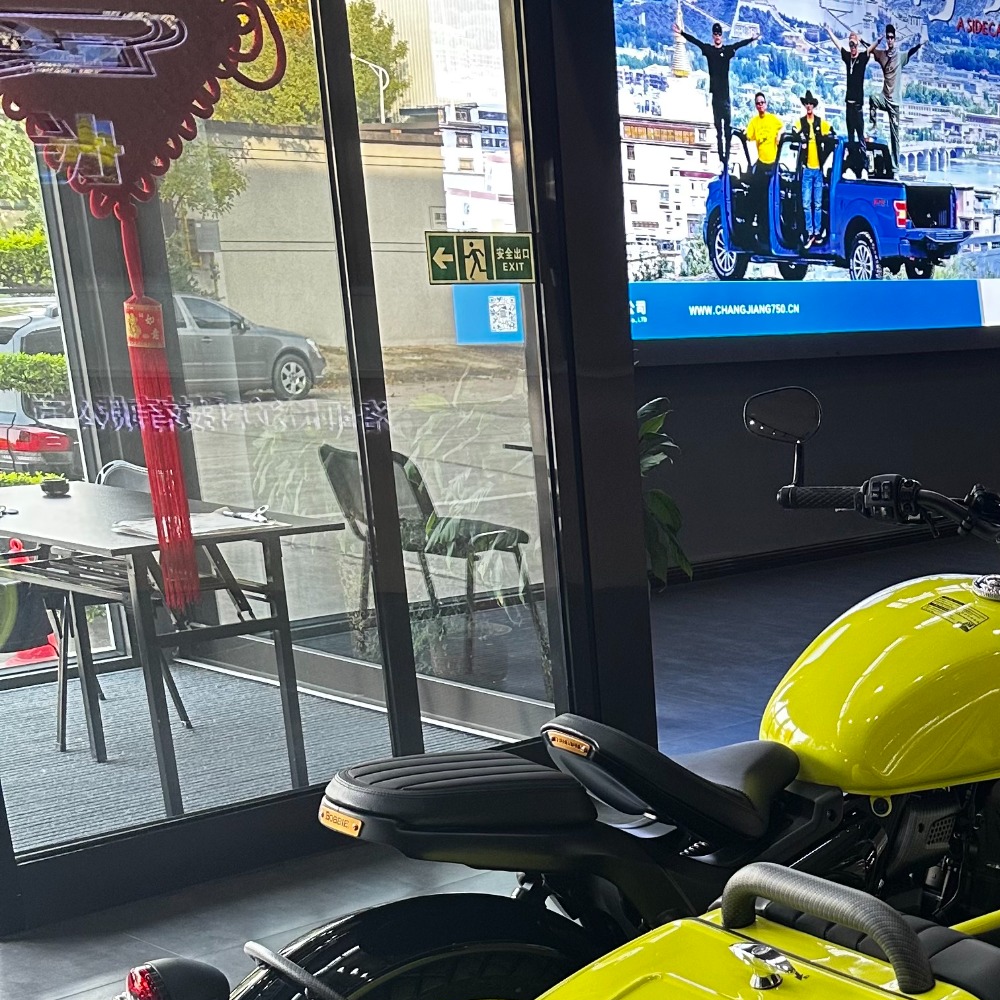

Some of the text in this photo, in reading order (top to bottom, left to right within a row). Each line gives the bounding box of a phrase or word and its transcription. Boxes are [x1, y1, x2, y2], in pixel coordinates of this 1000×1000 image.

[956, 17, 965, 32] A
[496, 247, 530, 260] 安全出口
[503, 262, 524, 272] EXIT
[688, 304, 800, 316] WWW.CHANGJIANG750.CN
